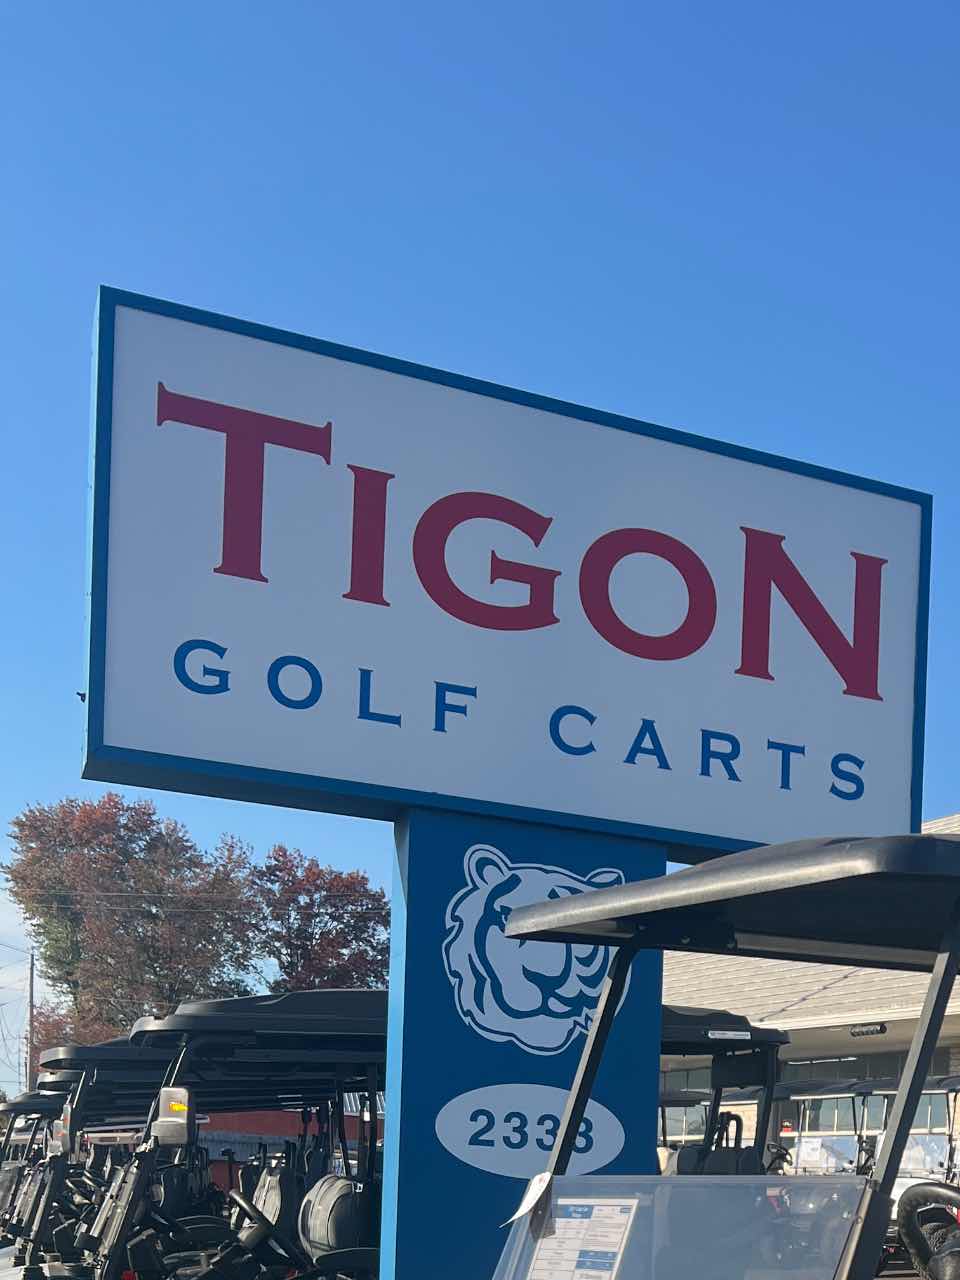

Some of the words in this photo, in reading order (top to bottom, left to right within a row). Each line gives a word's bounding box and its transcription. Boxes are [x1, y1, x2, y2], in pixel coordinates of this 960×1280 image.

[156, 380, 889, 701] TIGON
[173, 639, 478, 733] GOLF
[549, 705, 866, 801] CARTS
